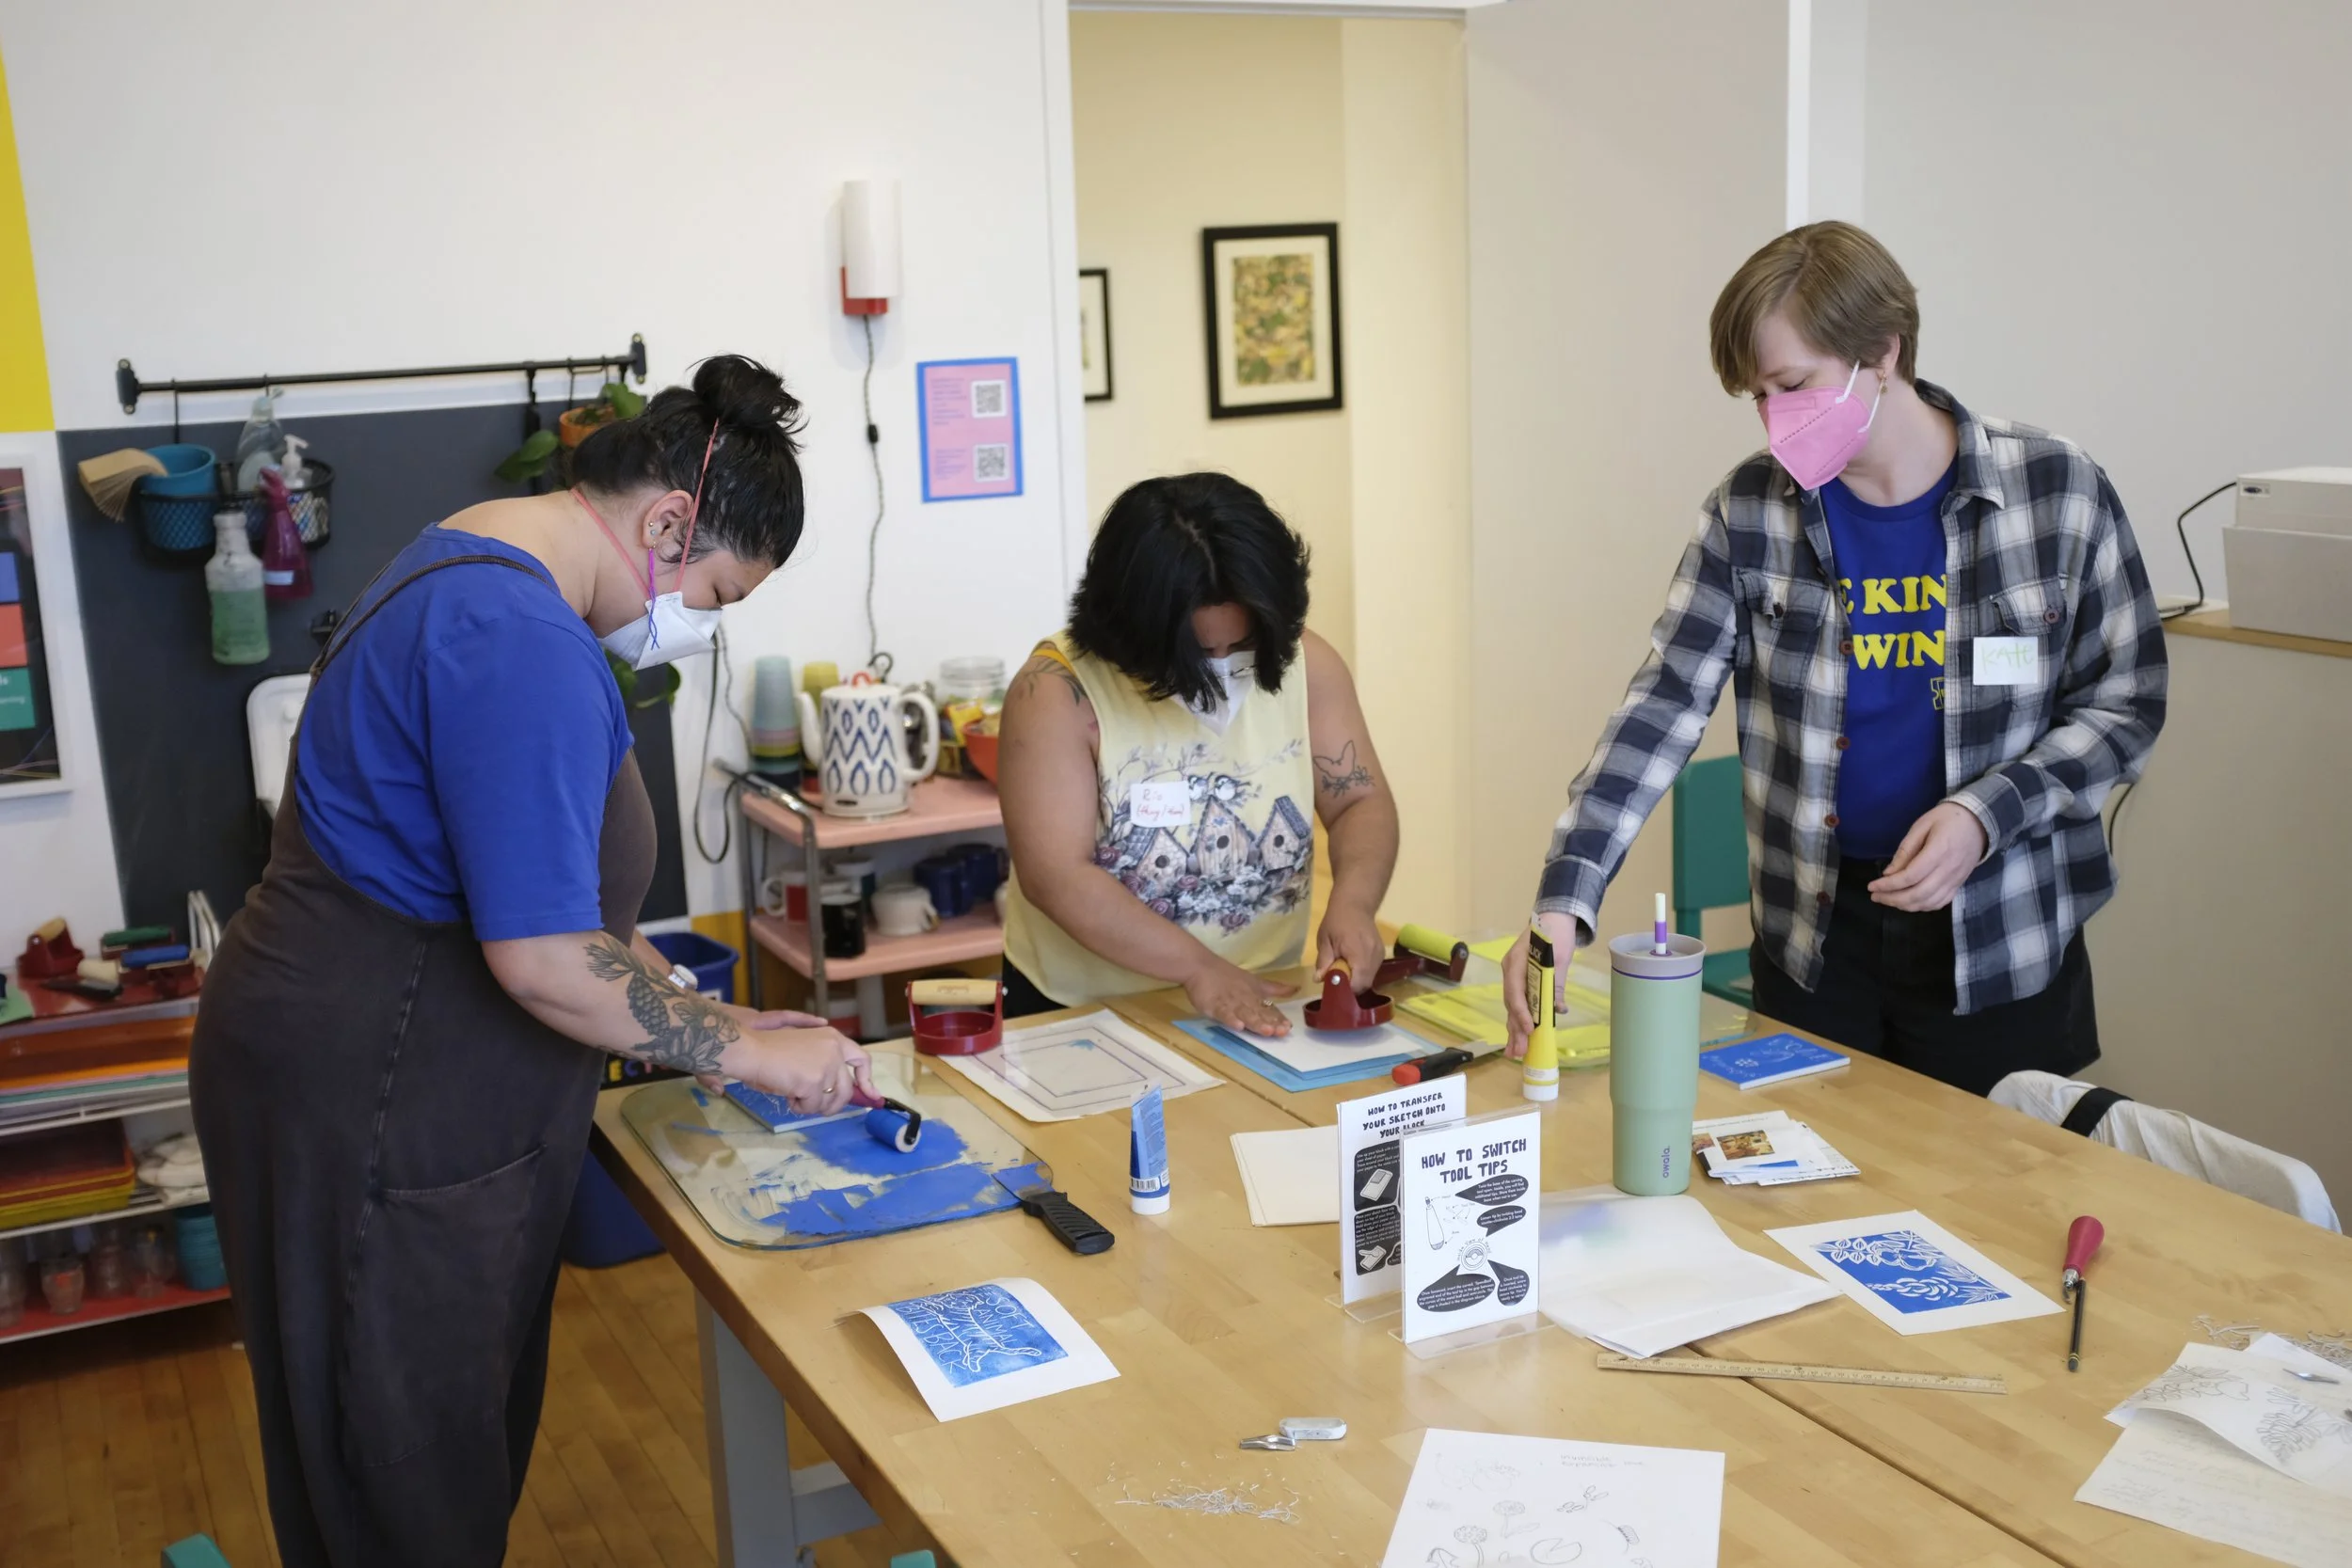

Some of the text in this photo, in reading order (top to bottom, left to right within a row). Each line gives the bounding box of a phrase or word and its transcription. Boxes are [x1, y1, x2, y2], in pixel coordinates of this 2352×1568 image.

[1362, 1103, 1446, 1131] YOUR SKETCH ONTO
[1368, 1092, 1442, 1116] HOW TO TRANSFER
[1379, 1126, 1400, 1138] YOUR
[1422, 1138, 1527, 1169] HOW TO SWITCH
[1439, 1159, 1508, 1183] TOOL TIPS
[986, 1295, 1035, 1329] SOFT
[973, 1309, 1018, 1348] ANIMAL
[923, 1331, 967, 1374] BACK
